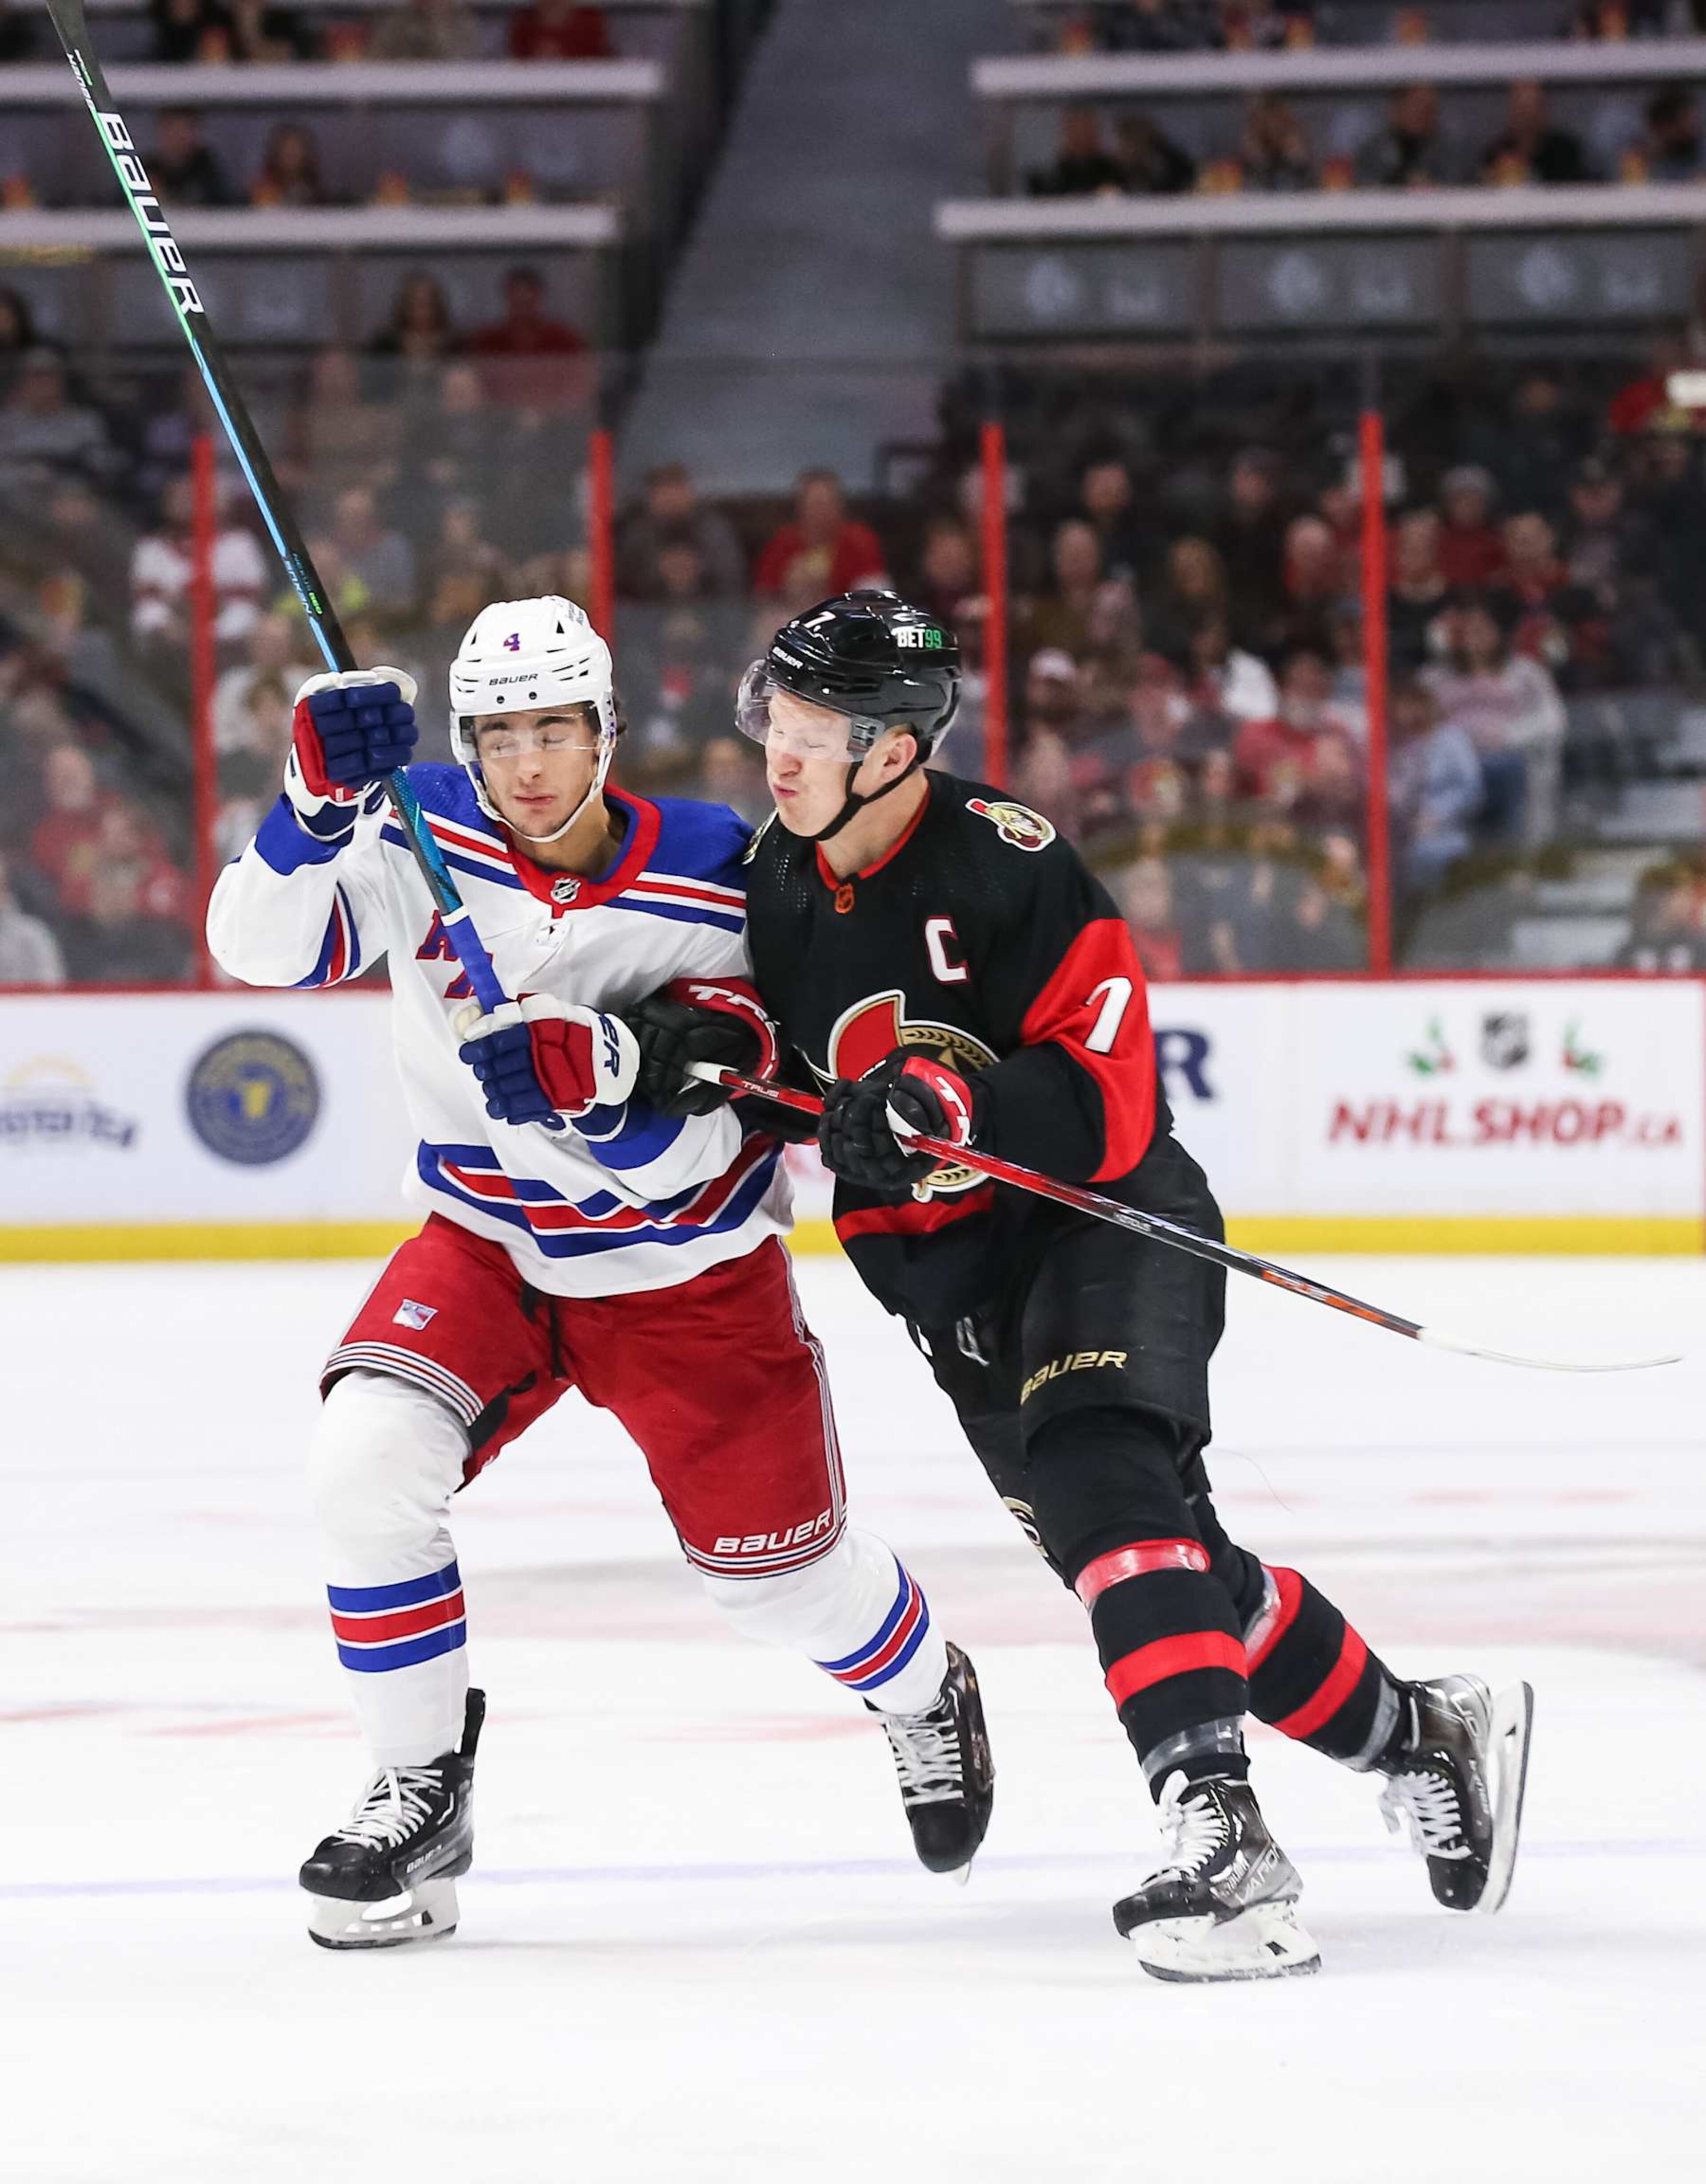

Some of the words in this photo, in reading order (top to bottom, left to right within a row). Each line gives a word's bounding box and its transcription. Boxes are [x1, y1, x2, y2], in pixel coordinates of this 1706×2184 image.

[98, 112, 205, 314] BAUER
[503, 633, 520, 651] 4
[804, 611, 837, 629] 7
[897, 627, 942, 649] BET99
[489, 673, 538, 686] BAUER
[925, 916, 969, 984] C
[1084, 976, 1133, 1054] 7
[1020, 1350, 1128, 1405] BAUER
[713, 1508, 832, 1553] BAUER
